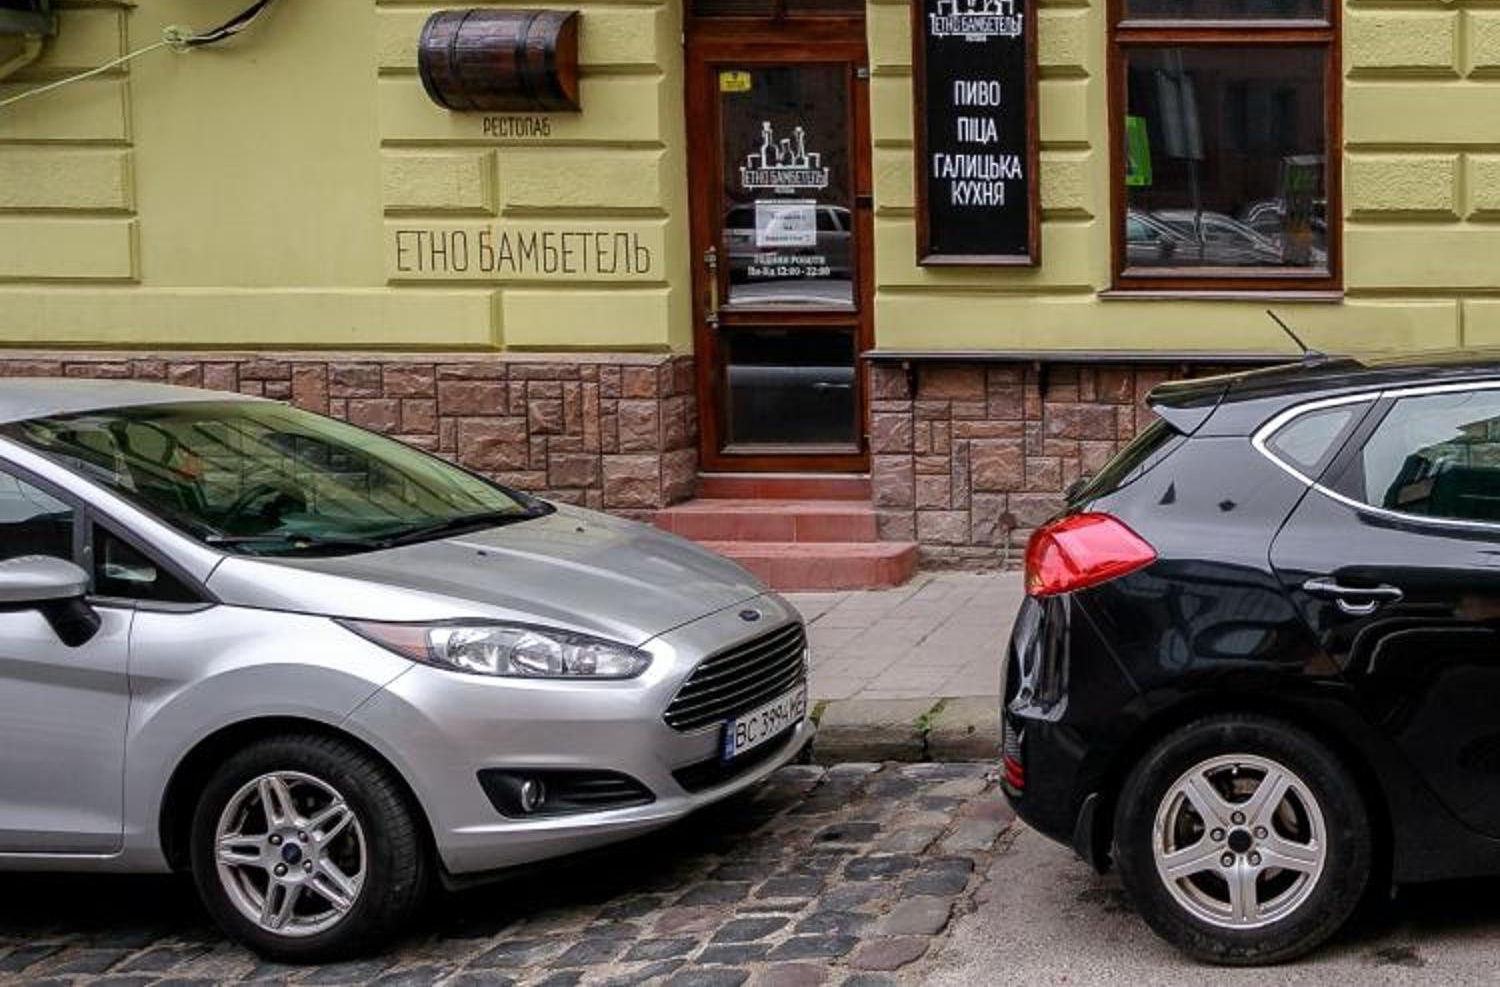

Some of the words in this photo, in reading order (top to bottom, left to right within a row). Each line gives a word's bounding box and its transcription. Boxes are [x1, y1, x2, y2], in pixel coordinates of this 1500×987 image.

[954, 80, 1001, 106] ПИВО
[483, 117, 551, 137] РЕСТОПАБ
[957, 116, 998, 144] ПІЦА
[934, 153, 1023, 181] ГАЛИЦЬКА
[951, 180, 1005, 206] КУХНЯ
[396, 230, 469, 272] ЕТНО
[479, 230, 651, 274] БАМБЕТЕЛЬ
[736, 717, 757, 748] BC
